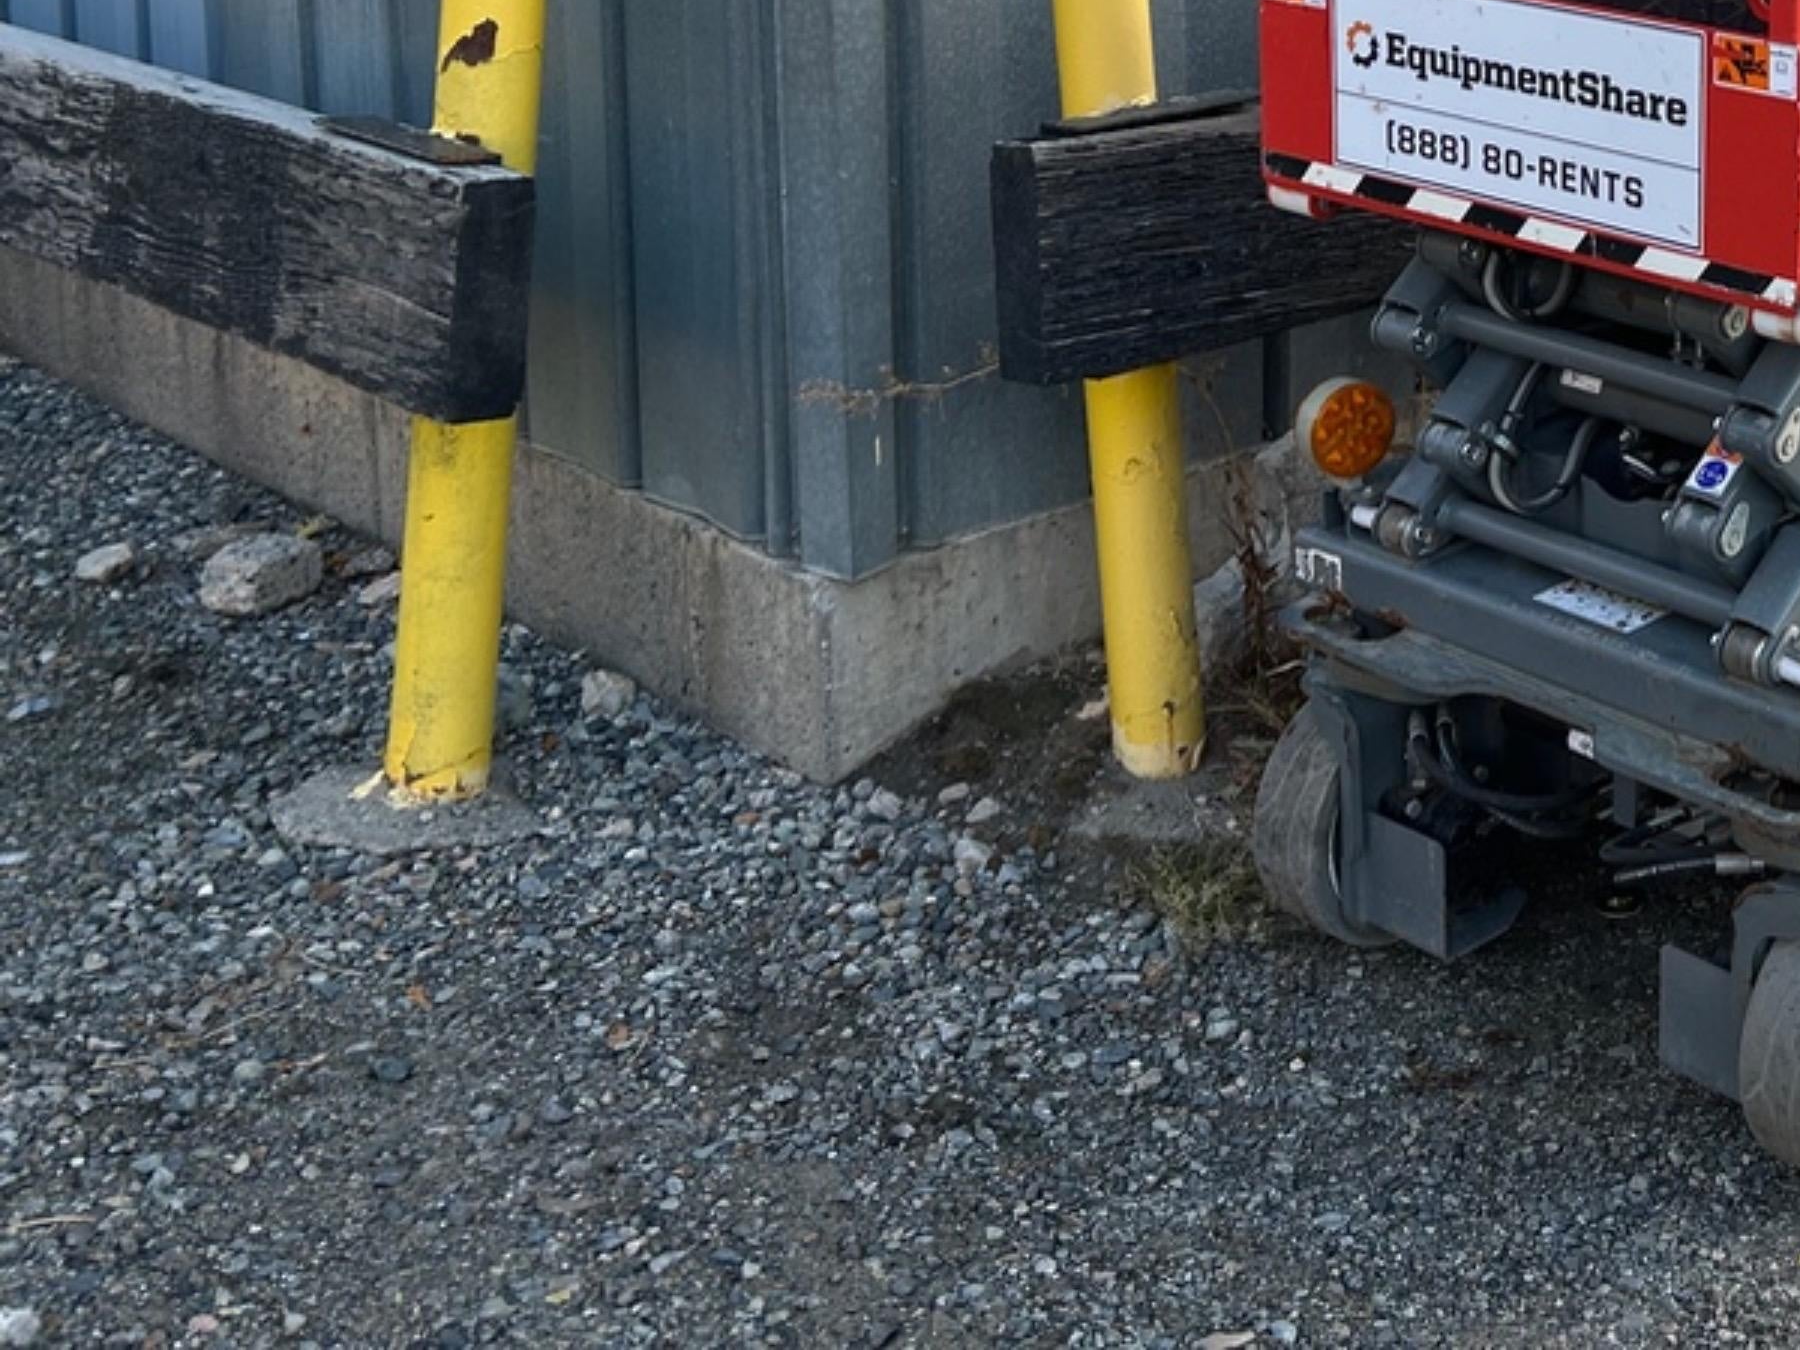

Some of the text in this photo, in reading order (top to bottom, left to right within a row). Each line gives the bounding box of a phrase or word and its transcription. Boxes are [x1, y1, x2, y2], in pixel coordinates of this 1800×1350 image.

[1386, 32, 1688, 126] EquipmentShare
[1386, 119, 1645, 209] (888) 80-RENTS
